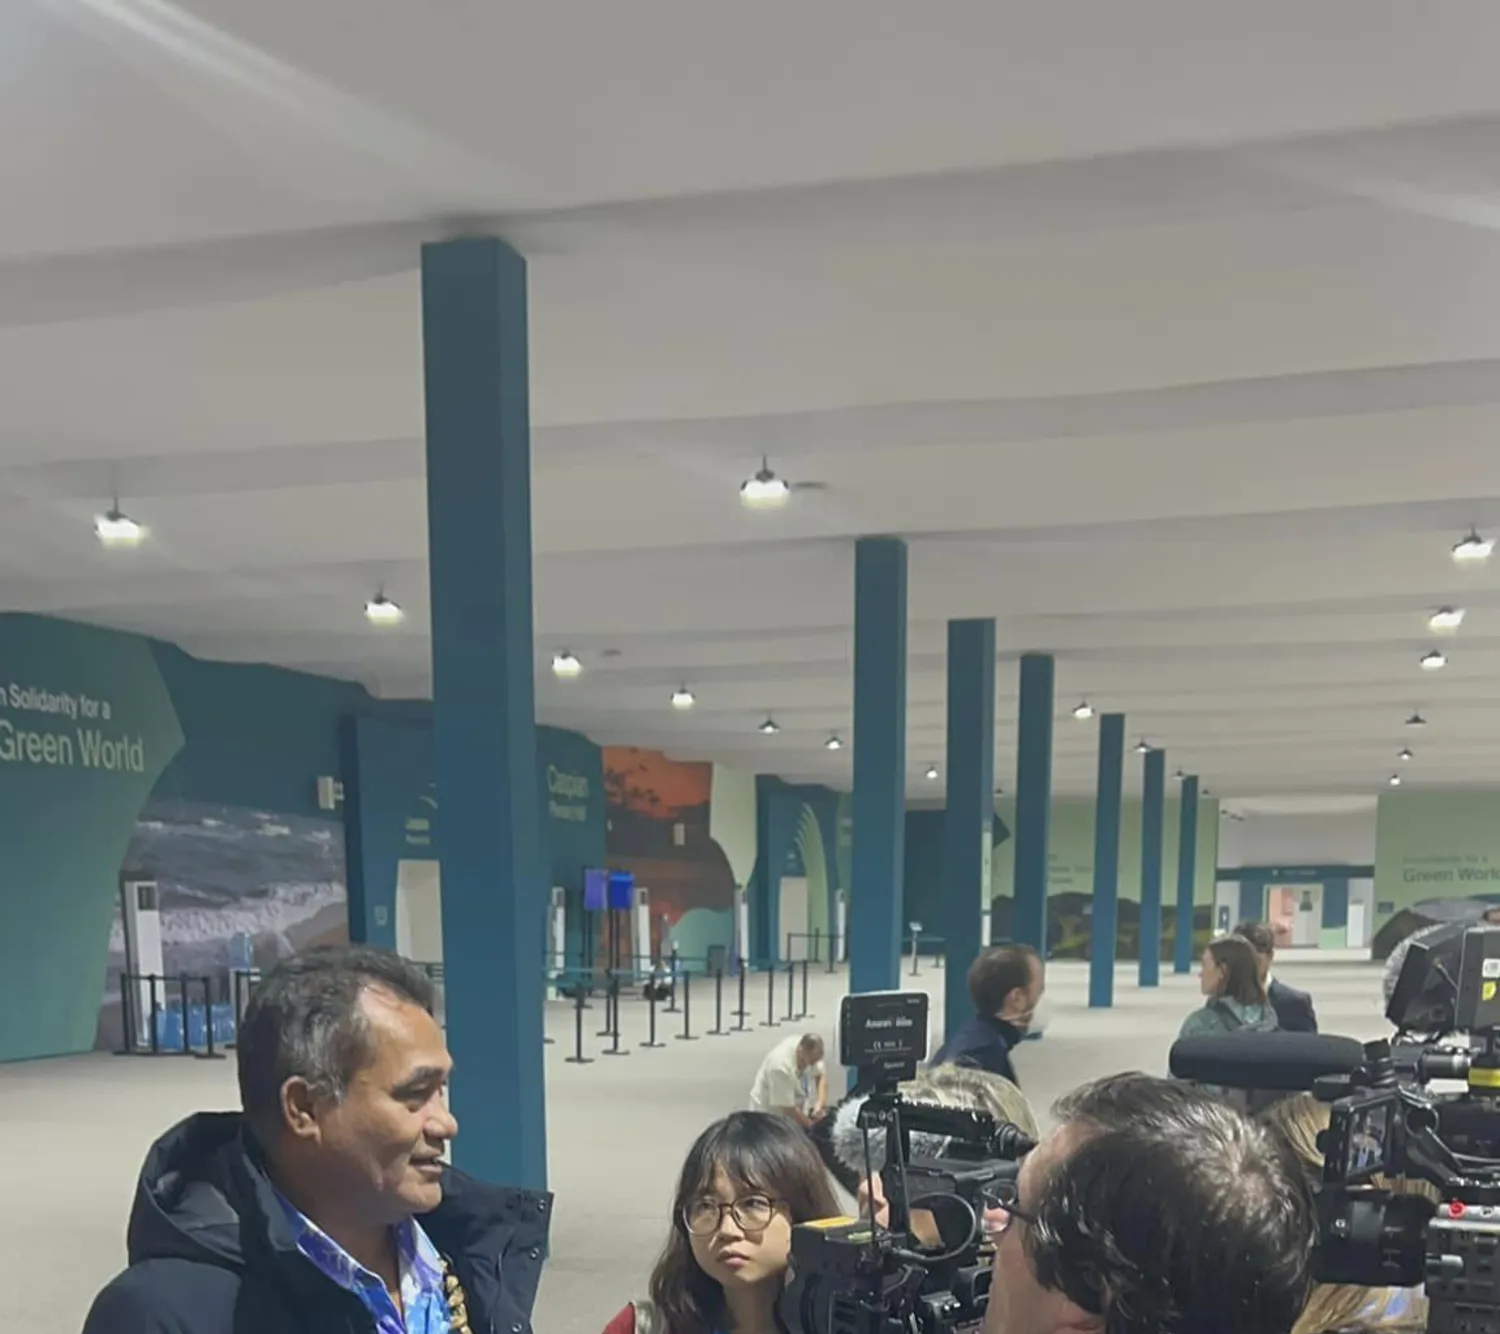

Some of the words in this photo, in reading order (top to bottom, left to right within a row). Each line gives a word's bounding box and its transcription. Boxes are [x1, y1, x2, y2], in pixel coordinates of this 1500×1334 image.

[9, 683, 77, 720] Solidarity
[80, 693, 98, 718] for
[101, 701, 111, 720] a
[0, 718, 73, 765] Green
[76, 727, 144, 773] World
[1403, 867, 1454, 883] Green
